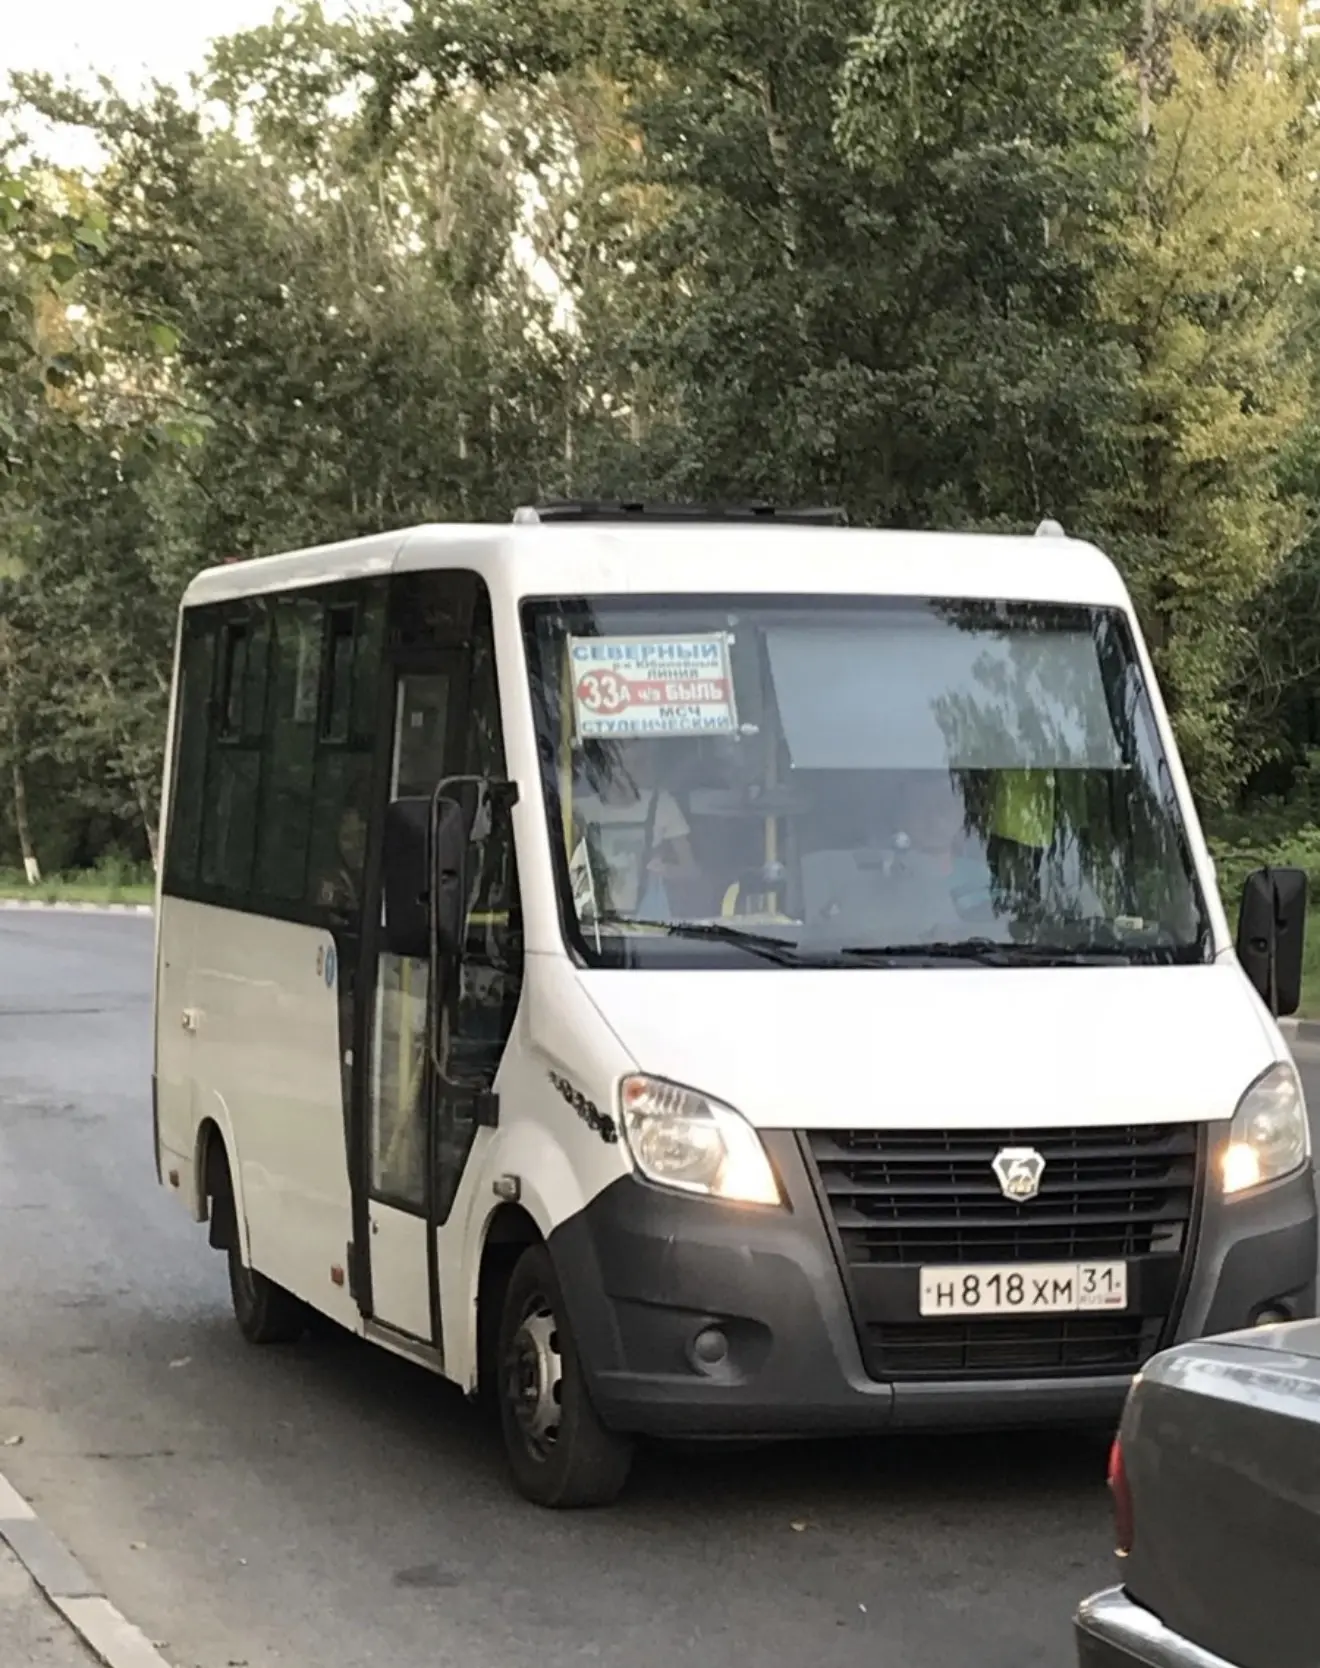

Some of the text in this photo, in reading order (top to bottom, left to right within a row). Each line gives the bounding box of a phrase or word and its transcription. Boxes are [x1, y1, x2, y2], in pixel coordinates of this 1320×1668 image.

[573, 643, 718, 661] СЕВЕРНЫЙ
[665, 682, 723, 701] БЫЛЬ
[659, 705, 701, 717] МСЧ
